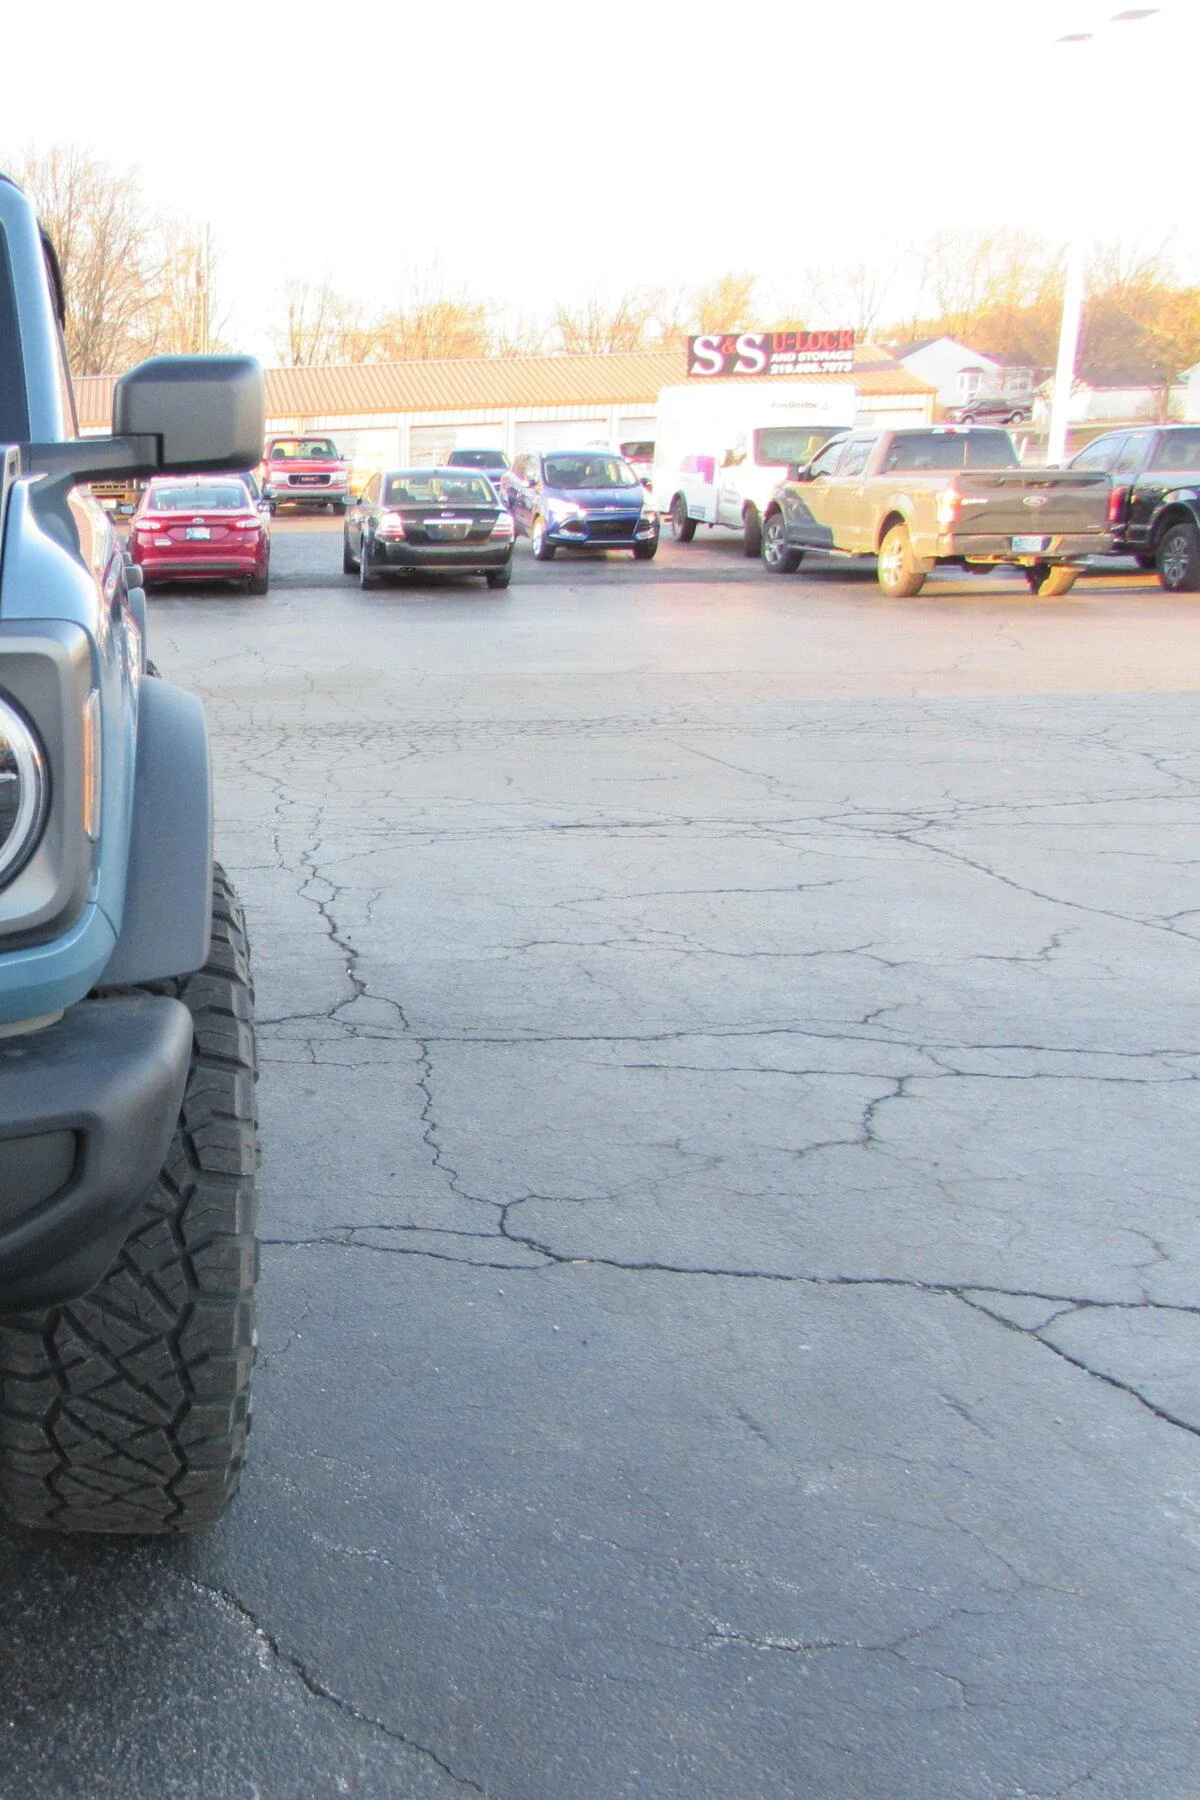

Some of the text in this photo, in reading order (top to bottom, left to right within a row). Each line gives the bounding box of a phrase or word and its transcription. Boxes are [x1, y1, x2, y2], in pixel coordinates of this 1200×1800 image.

[772, 332, 853, 349] U-LOCK
[690, 334, 766, 375] S&S
[771, 351, 853, 363] AND STORAGE
